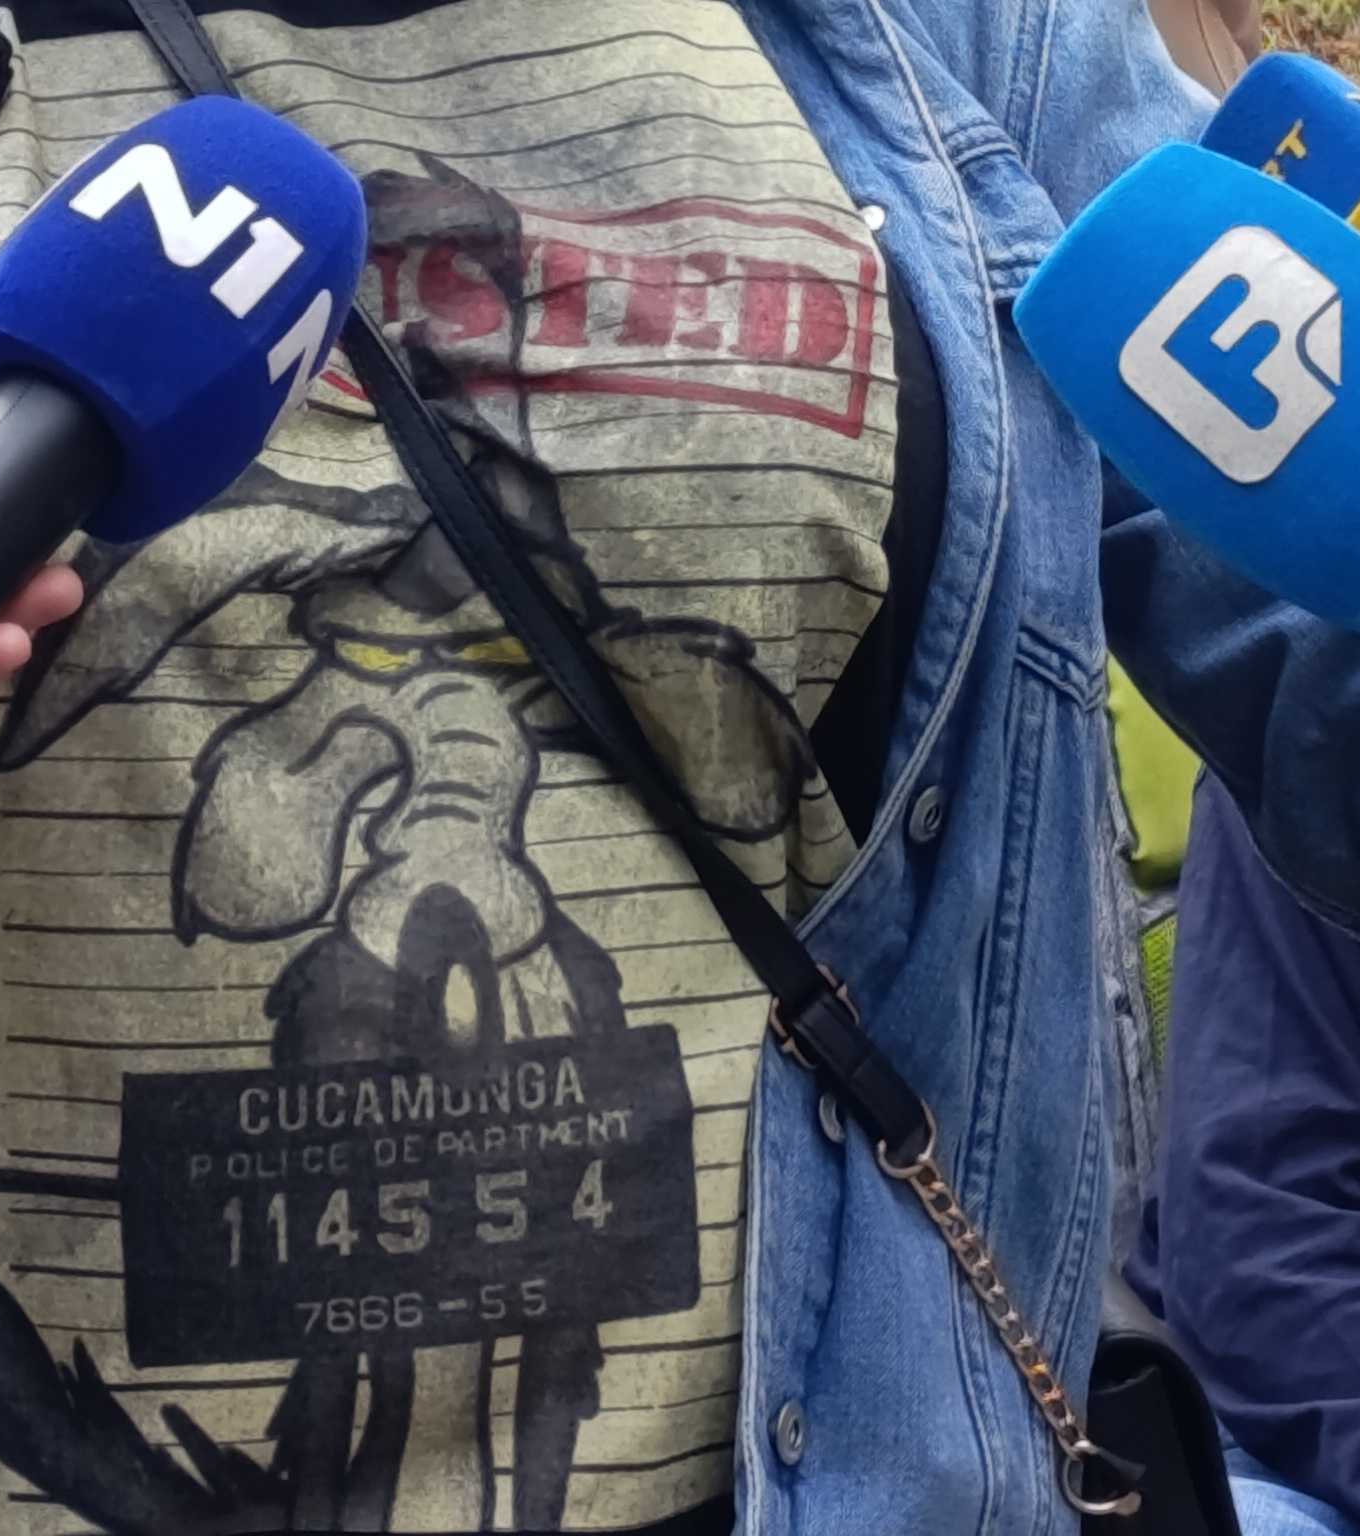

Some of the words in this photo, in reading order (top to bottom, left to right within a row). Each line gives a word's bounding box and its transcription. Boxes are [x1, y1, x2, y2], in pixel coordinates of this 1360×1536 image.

[69, 144, 305, 319] N1
[368, 234, 850, 366] STED
[189, 1138, 350, 1182] POLICE
